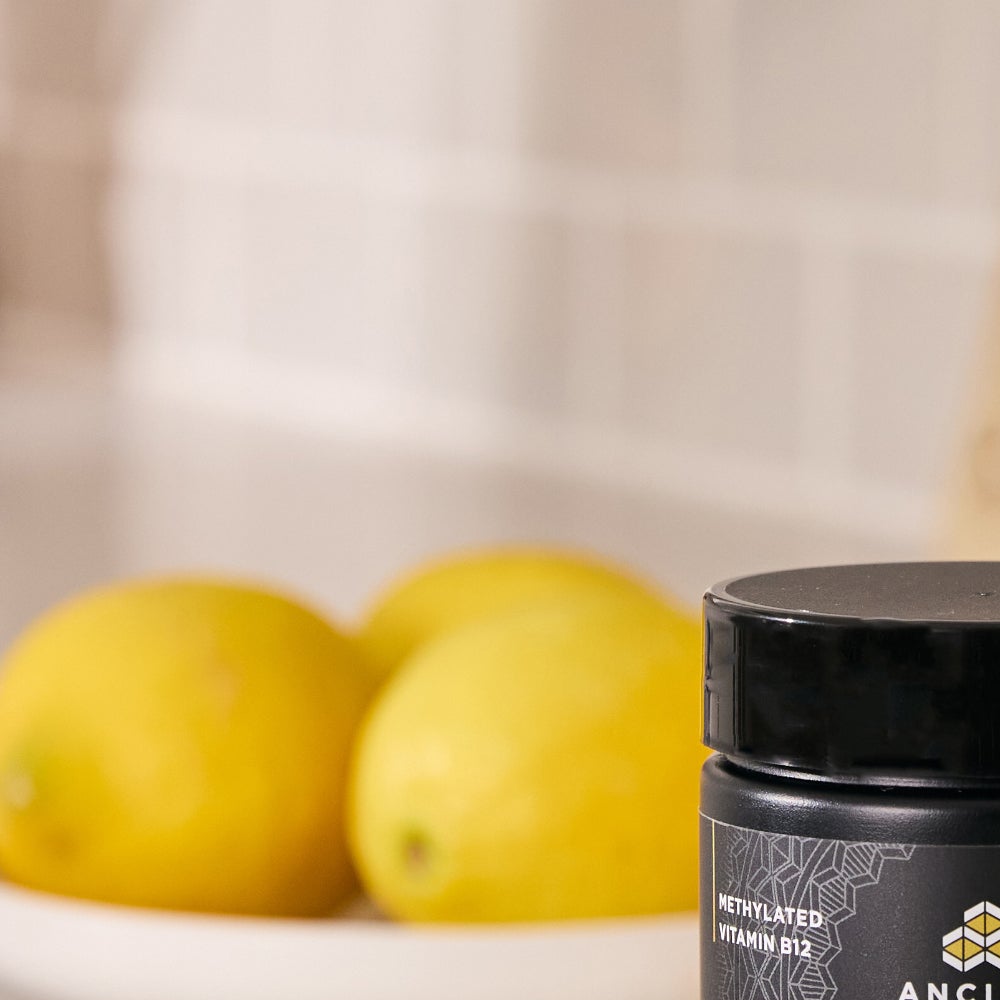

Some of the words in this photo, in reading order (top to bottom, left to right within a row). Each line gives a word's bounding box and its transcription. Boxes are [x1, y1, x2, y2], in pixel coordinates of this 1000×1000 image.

[718, 892, 823, 928] METHYLATED
[718, 922, 775, 952] VITAMIN
[780, 936, 812, 957] B12
